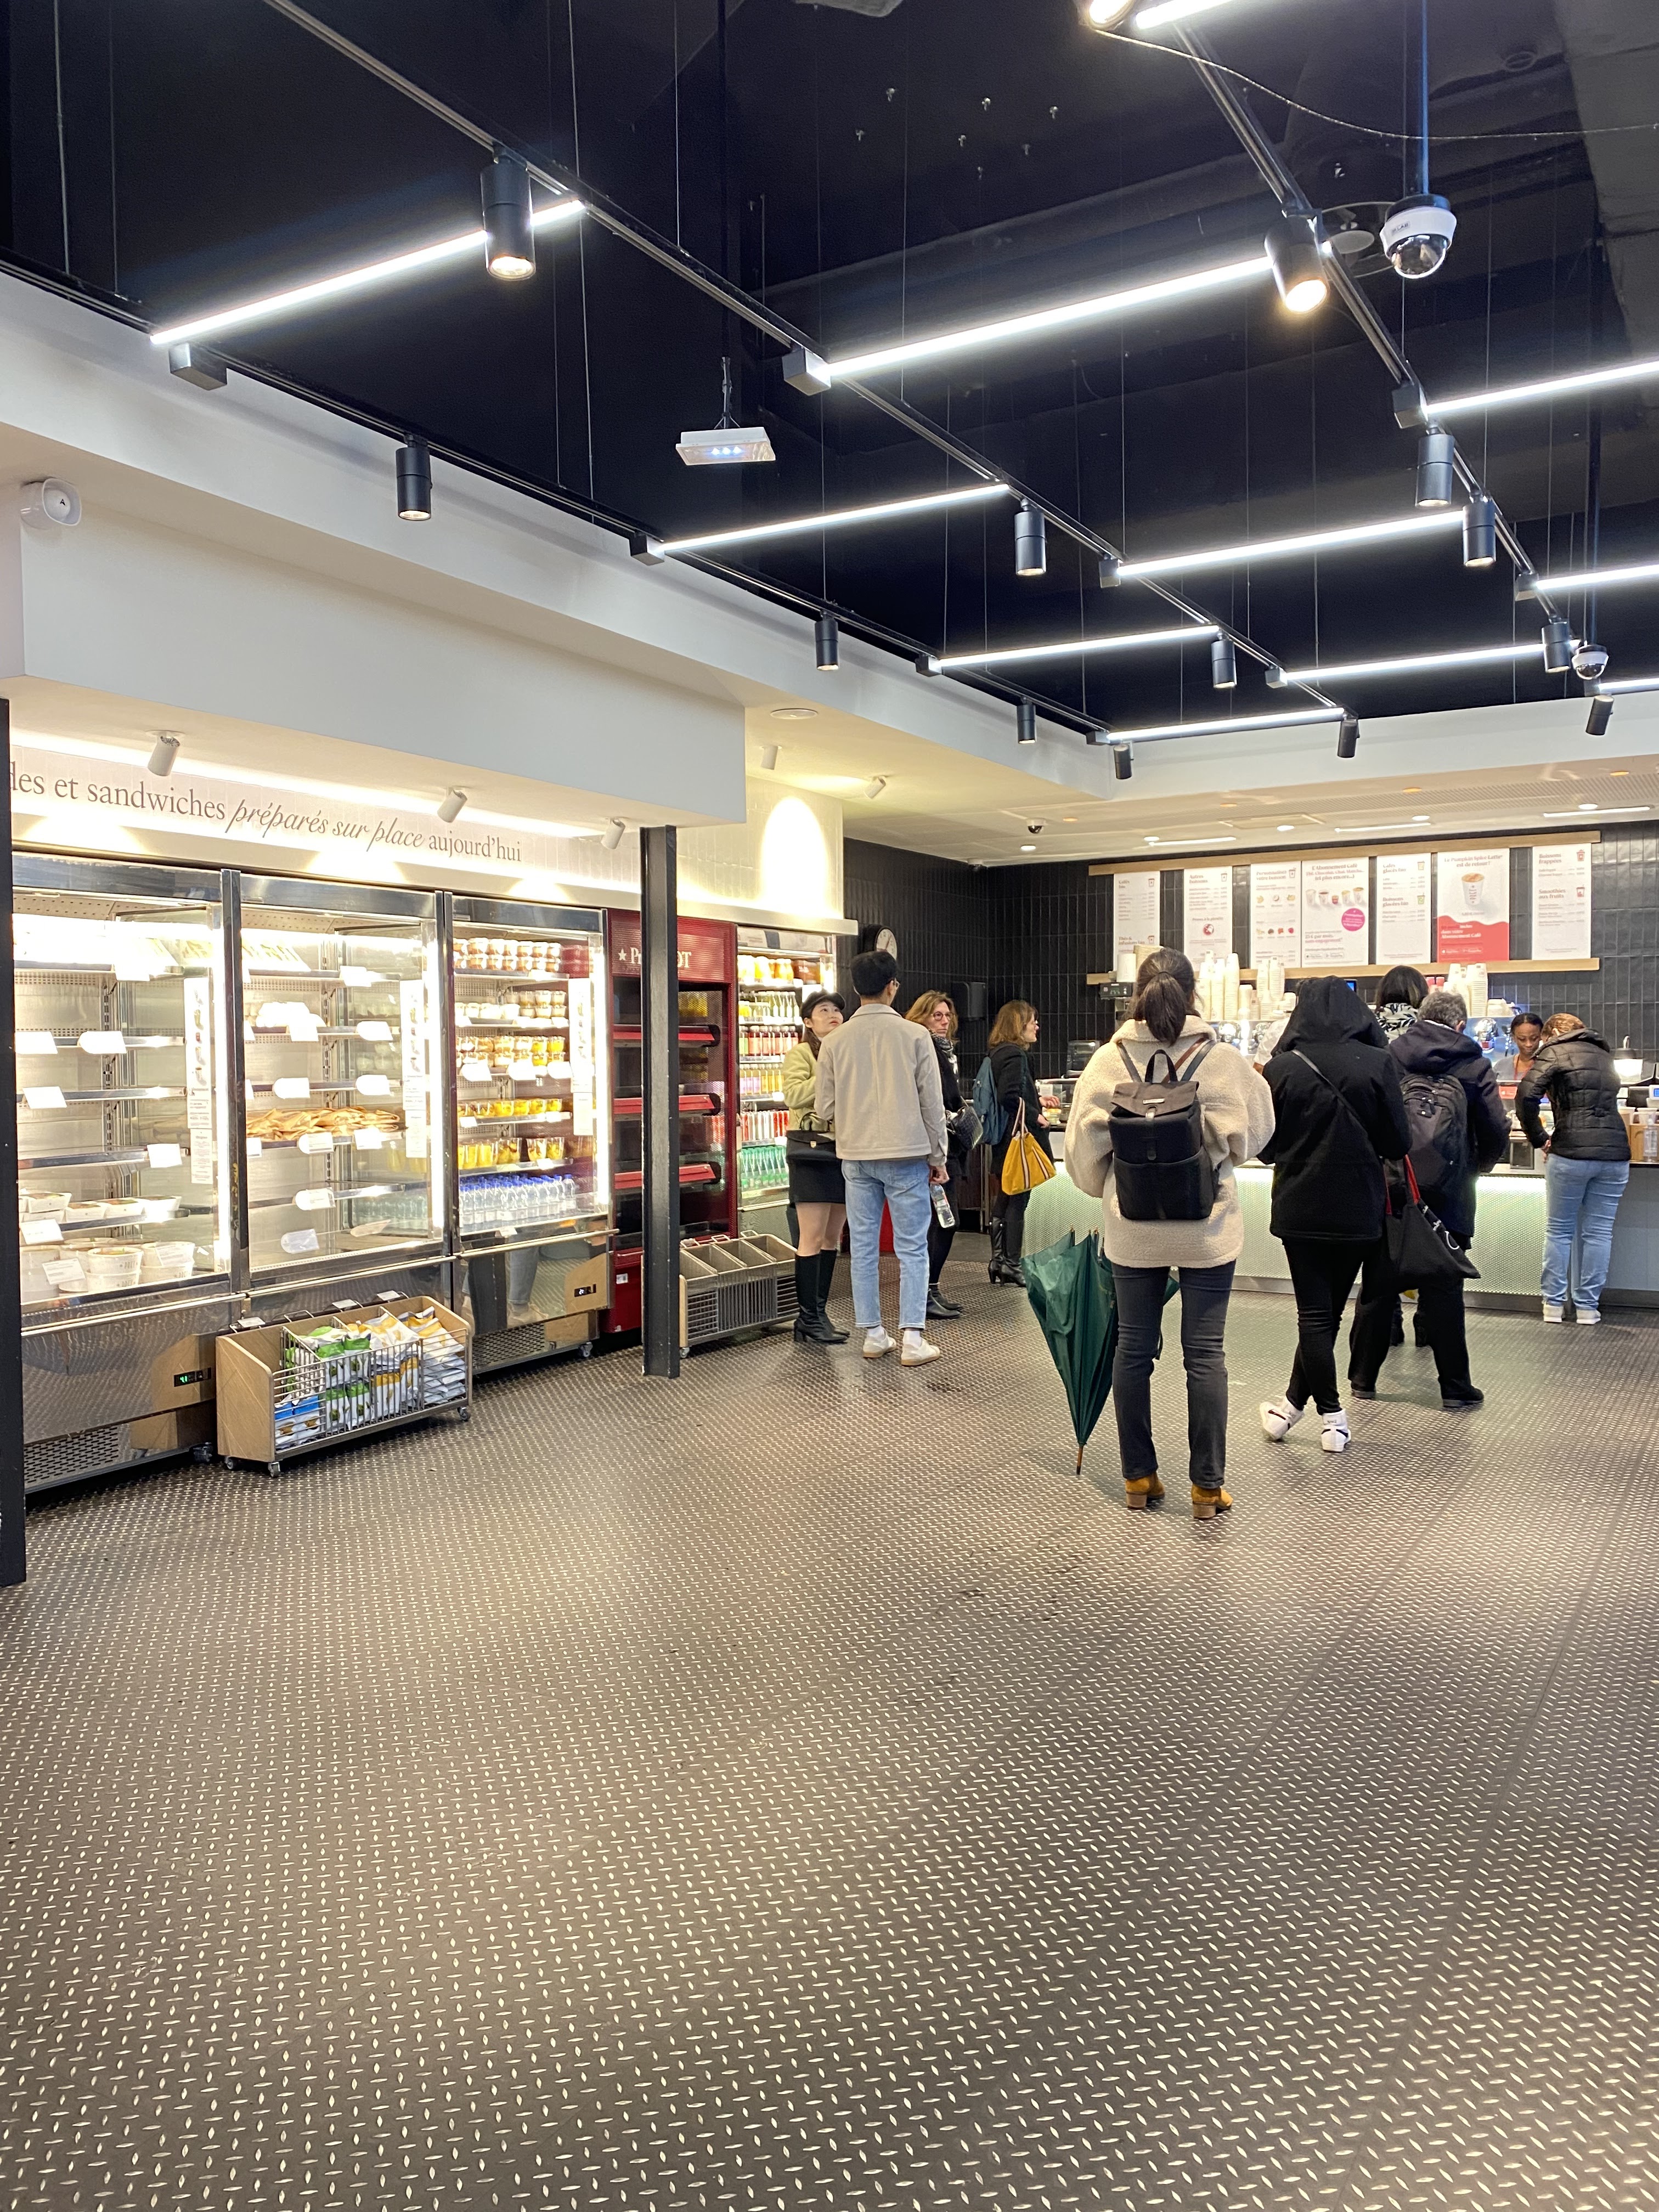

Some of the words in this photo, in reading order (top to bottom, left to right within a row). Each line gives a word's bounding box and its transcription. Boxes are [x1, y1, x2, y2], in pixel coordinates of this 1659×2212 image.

[54, 778, 78, 799] et
[87, 781, 225, 820] sandwiches
[224, 799, 329, 838] préparés
[332, 821, 370, 838] sur
[366, 817, 426, 852] place
[428, 830, 522, 862] aujourd'hui
